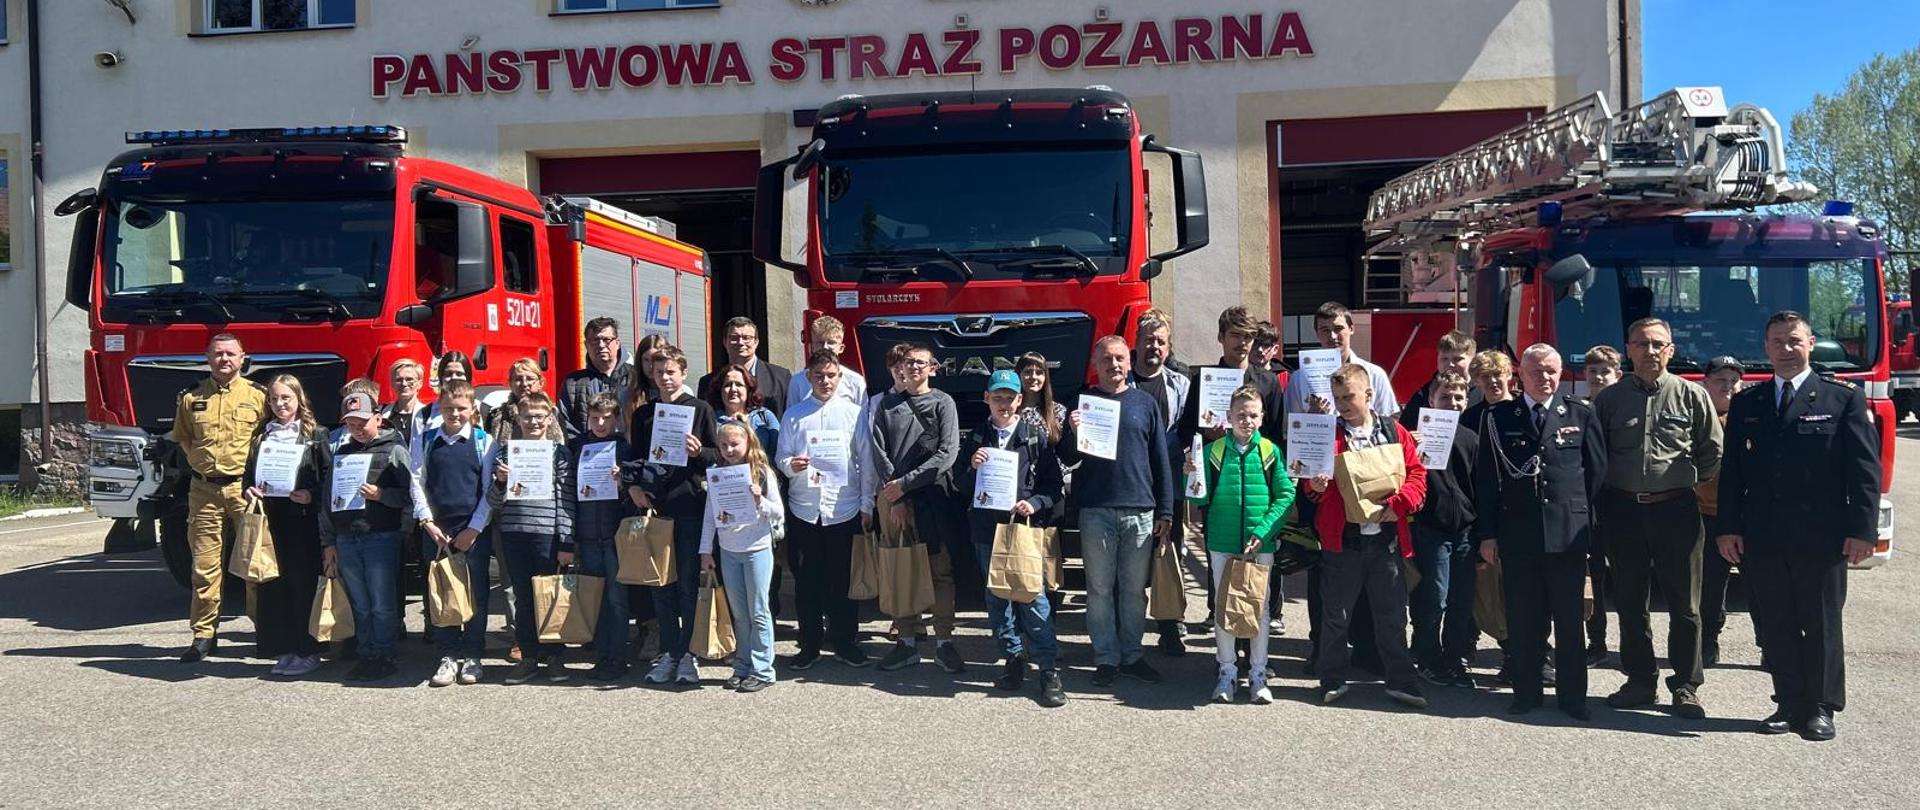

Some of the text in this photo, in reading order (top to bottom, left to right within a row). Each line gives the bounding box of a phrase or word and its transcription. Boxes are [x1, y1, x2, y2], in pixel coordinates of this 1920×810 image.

[371, 7, 1314, 99] PAŃSTWOWA STRAŻ POŻARNA
